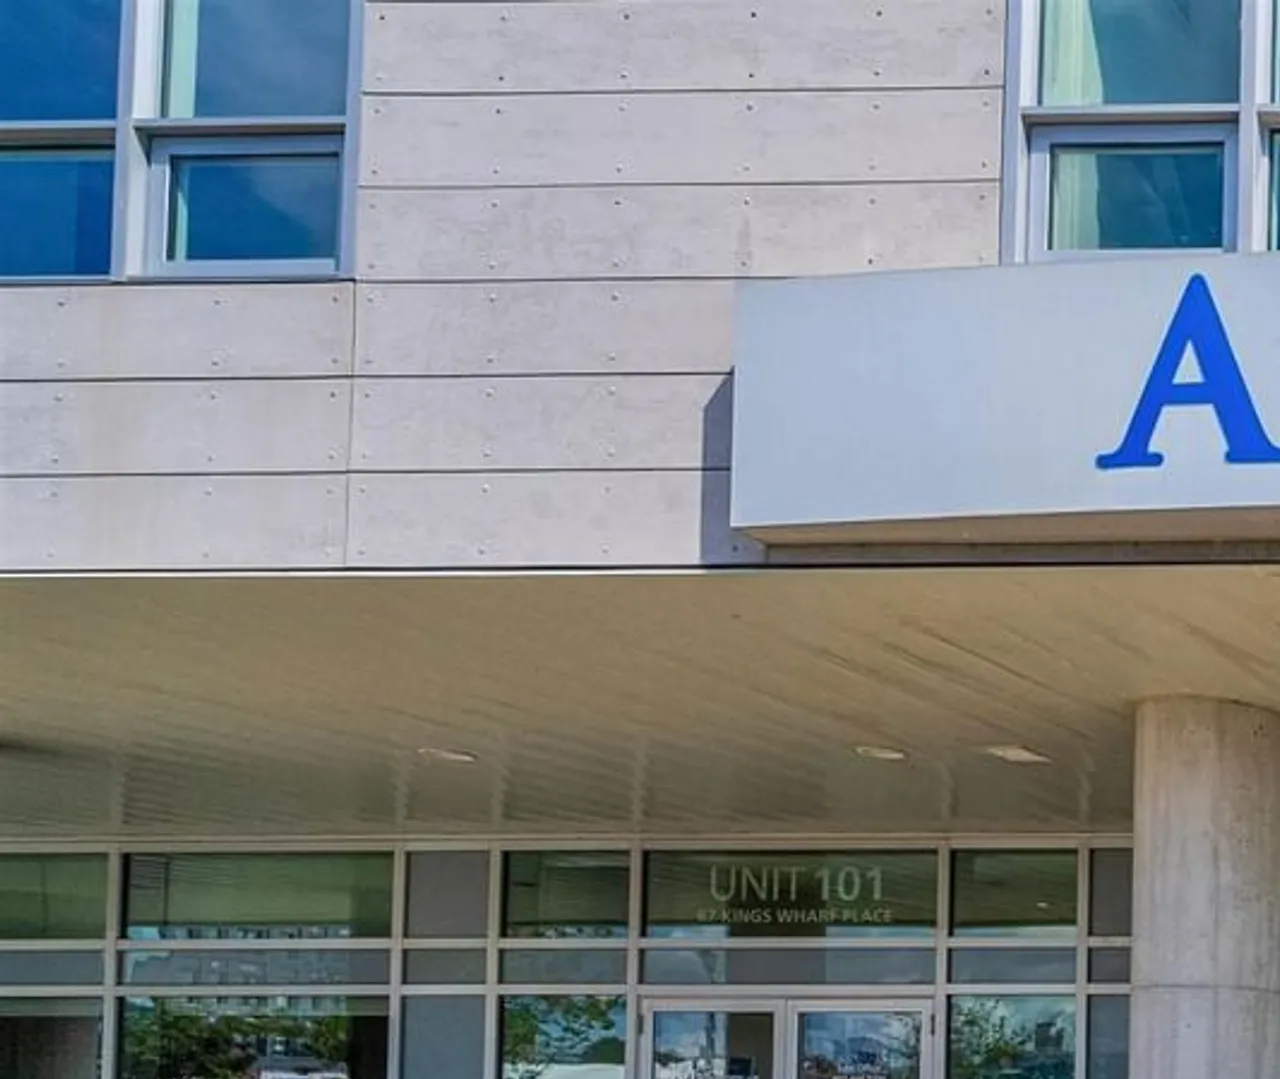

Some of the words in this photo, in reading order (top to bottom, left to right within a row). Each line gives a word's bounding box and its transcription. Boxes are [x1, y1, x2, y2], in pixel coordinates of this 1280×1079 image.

[709, 864, 805, 902] UNIT
[814, 865, 884, 902] 101
[721, 907, 773, 923] KINGS
[776, 907, 838, 923] WHARF
